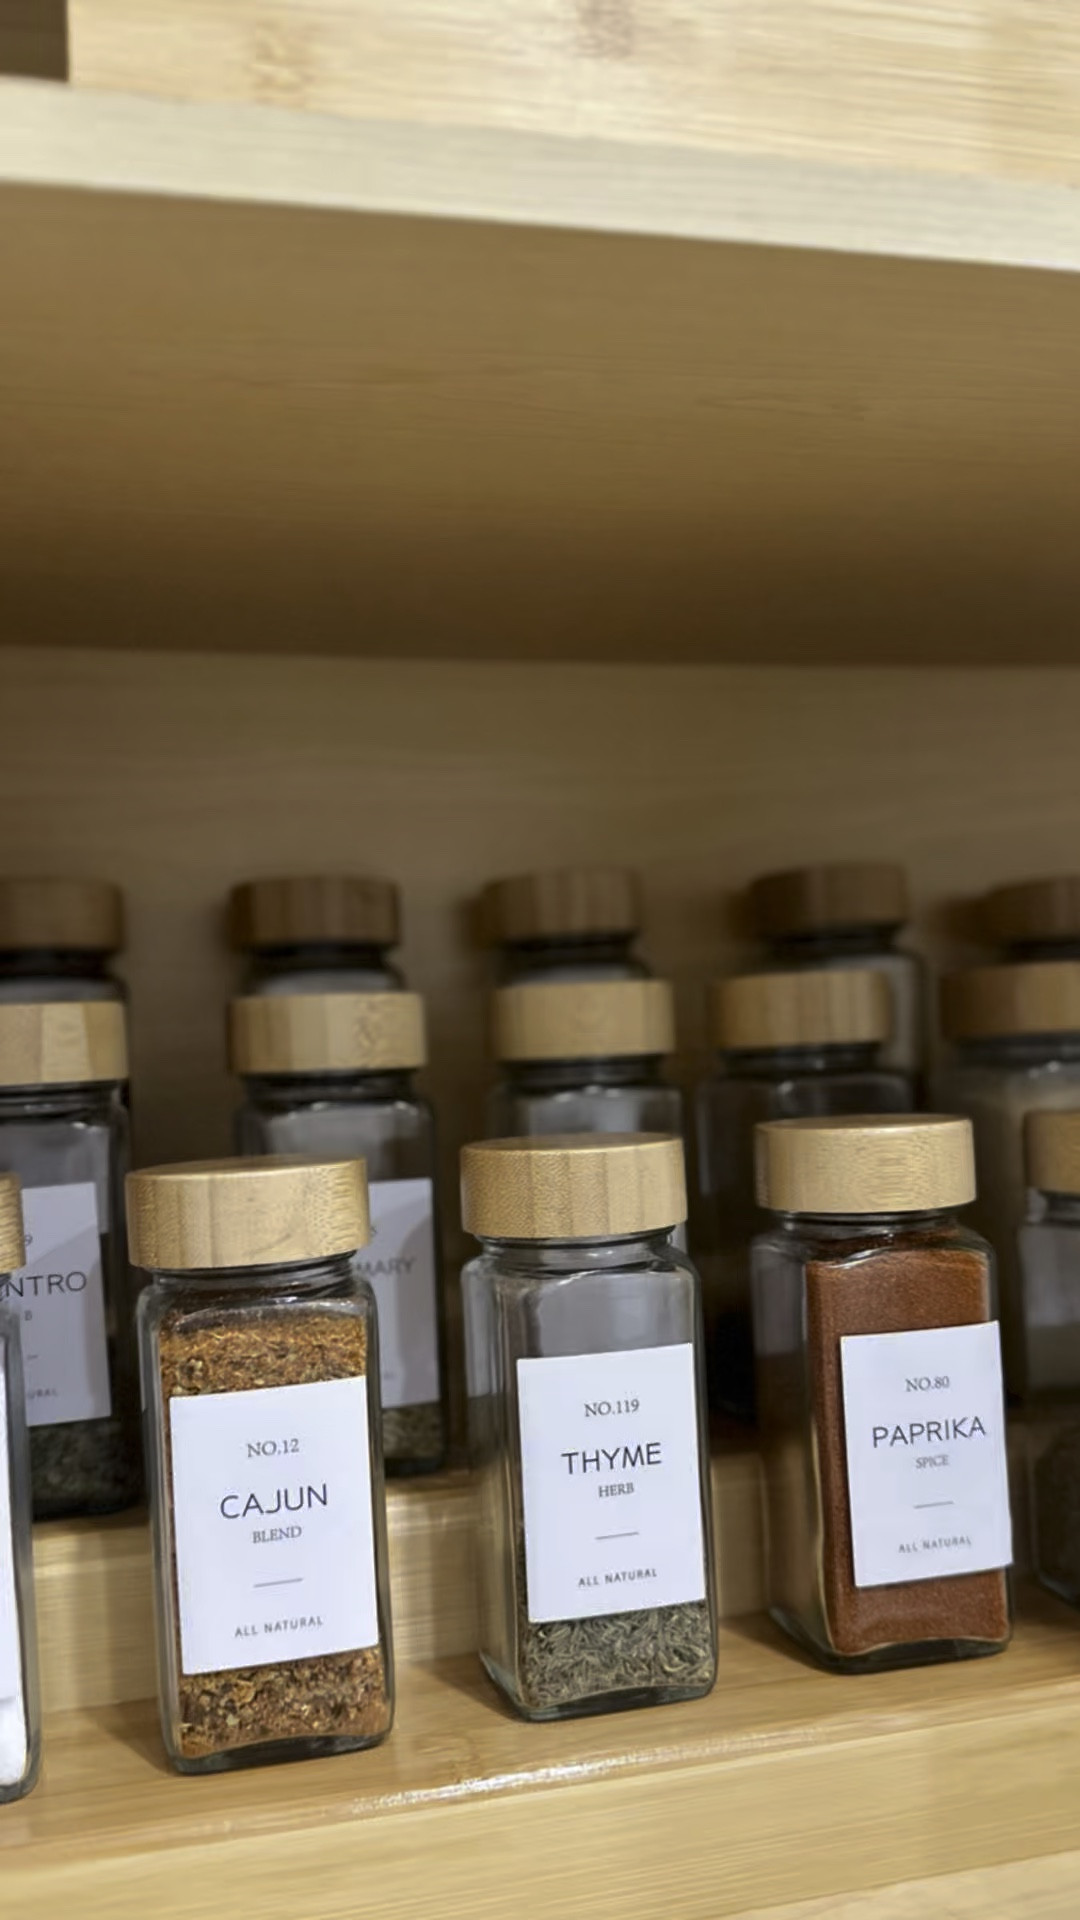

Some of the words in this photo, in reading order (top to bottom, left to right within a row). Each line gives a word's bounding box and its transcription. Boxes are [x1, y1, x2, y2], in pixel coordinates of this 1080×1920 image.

[904, 1375, 950, 1393] NO.80
[583, 1398, 640, 1418] NO.119
[872, 1415, 987, 1449] PAPRIKA
[246, 1437, 300, 1459] NO.12
[561, 1441, 662, 1475] THYME
[915, 1453, 950, 1470] SPICE
[597, 1481, 635, 1499] HERB
[219, 1482, 328, 1520] CAJUN
[252, 1525, 303, 1545] BLEND
[898, 1541, 920, 1554] ALL
[922, 1535, 972, 1551] NATURAL
[577, 1575, 600, 1588] ALL
[604, 1568, 658, 1585] NATURAL
[234, 1624, 259, 1638] ALL
[263, 1615, 324, 1634] NATURAL
